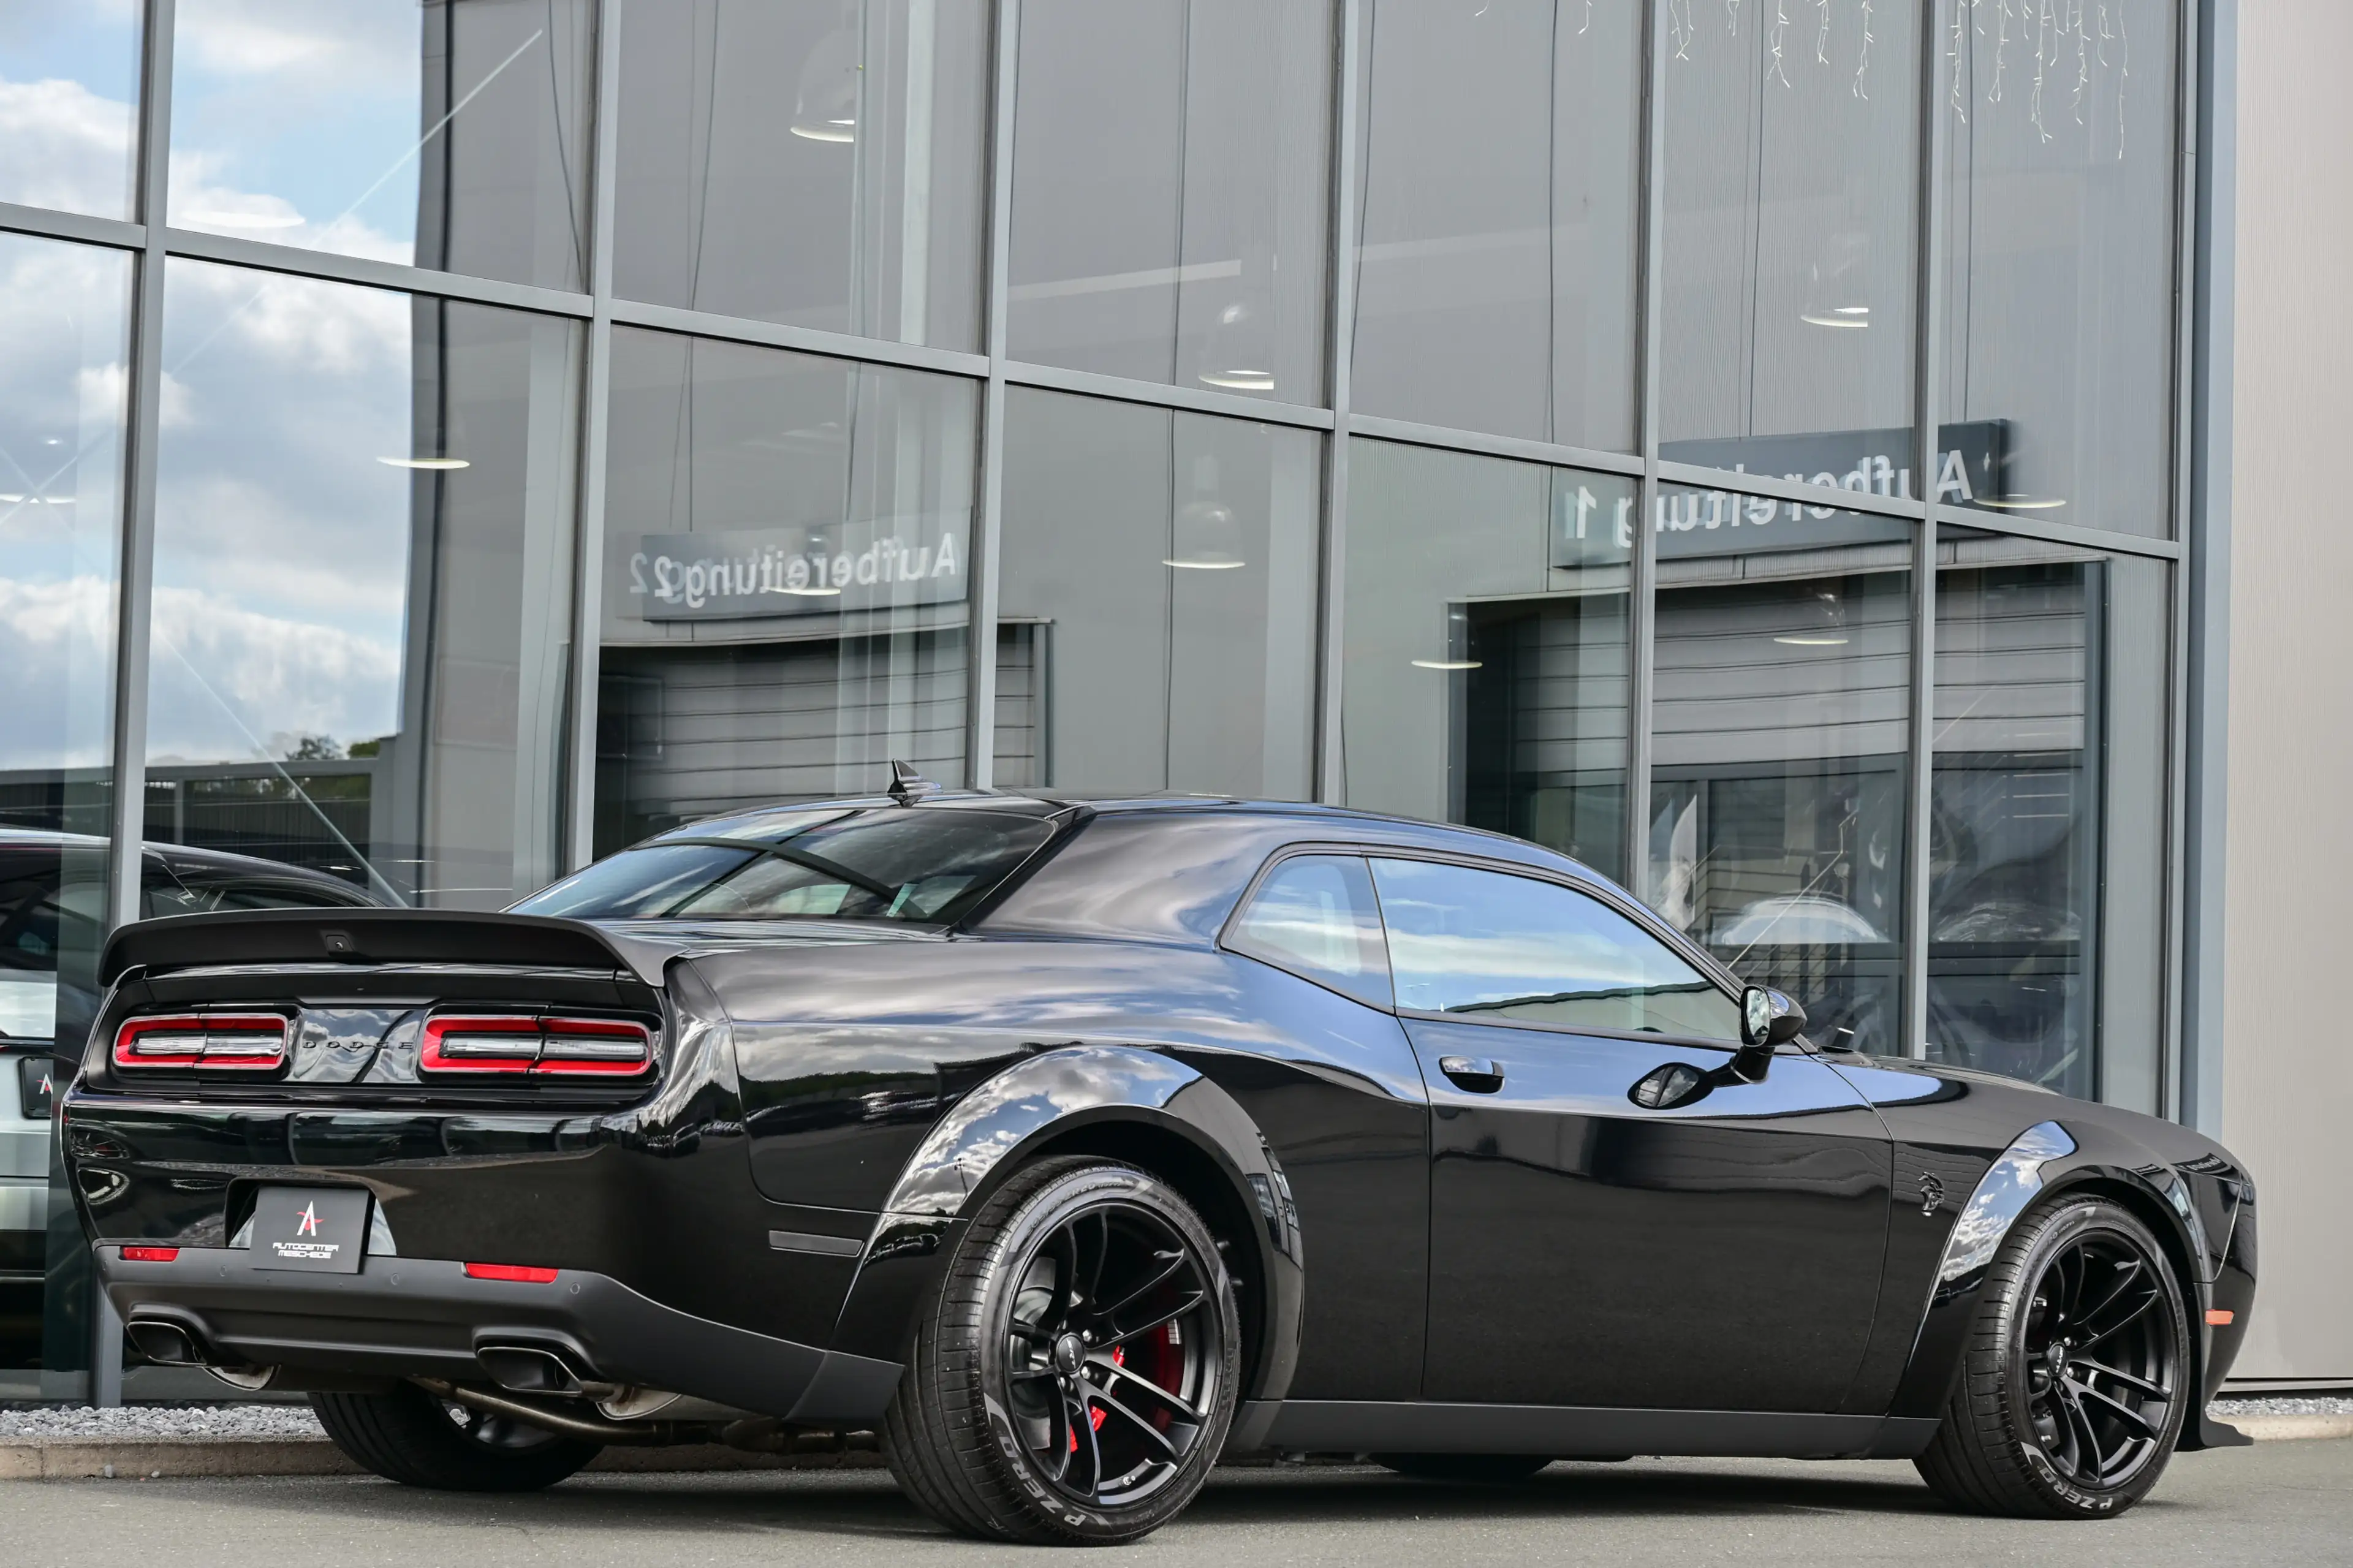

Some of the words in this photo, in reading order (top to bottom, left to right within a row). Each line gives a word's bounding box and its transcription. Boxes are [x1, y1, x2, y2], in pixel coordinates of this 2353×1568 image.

[303, 1040, 414, 1050] DODGE
[272, 1242, 339, 1252] AUTOCENTER
[278, 1249, 332, 1259] MESCHEDE
[998, 1436, 1064, 1513] ZERO
[2039, 1467, 2096, 1509] ZERO
[2099, 1497, 2113, 1510] P
[1064, 1513, 1086, 1526] P
